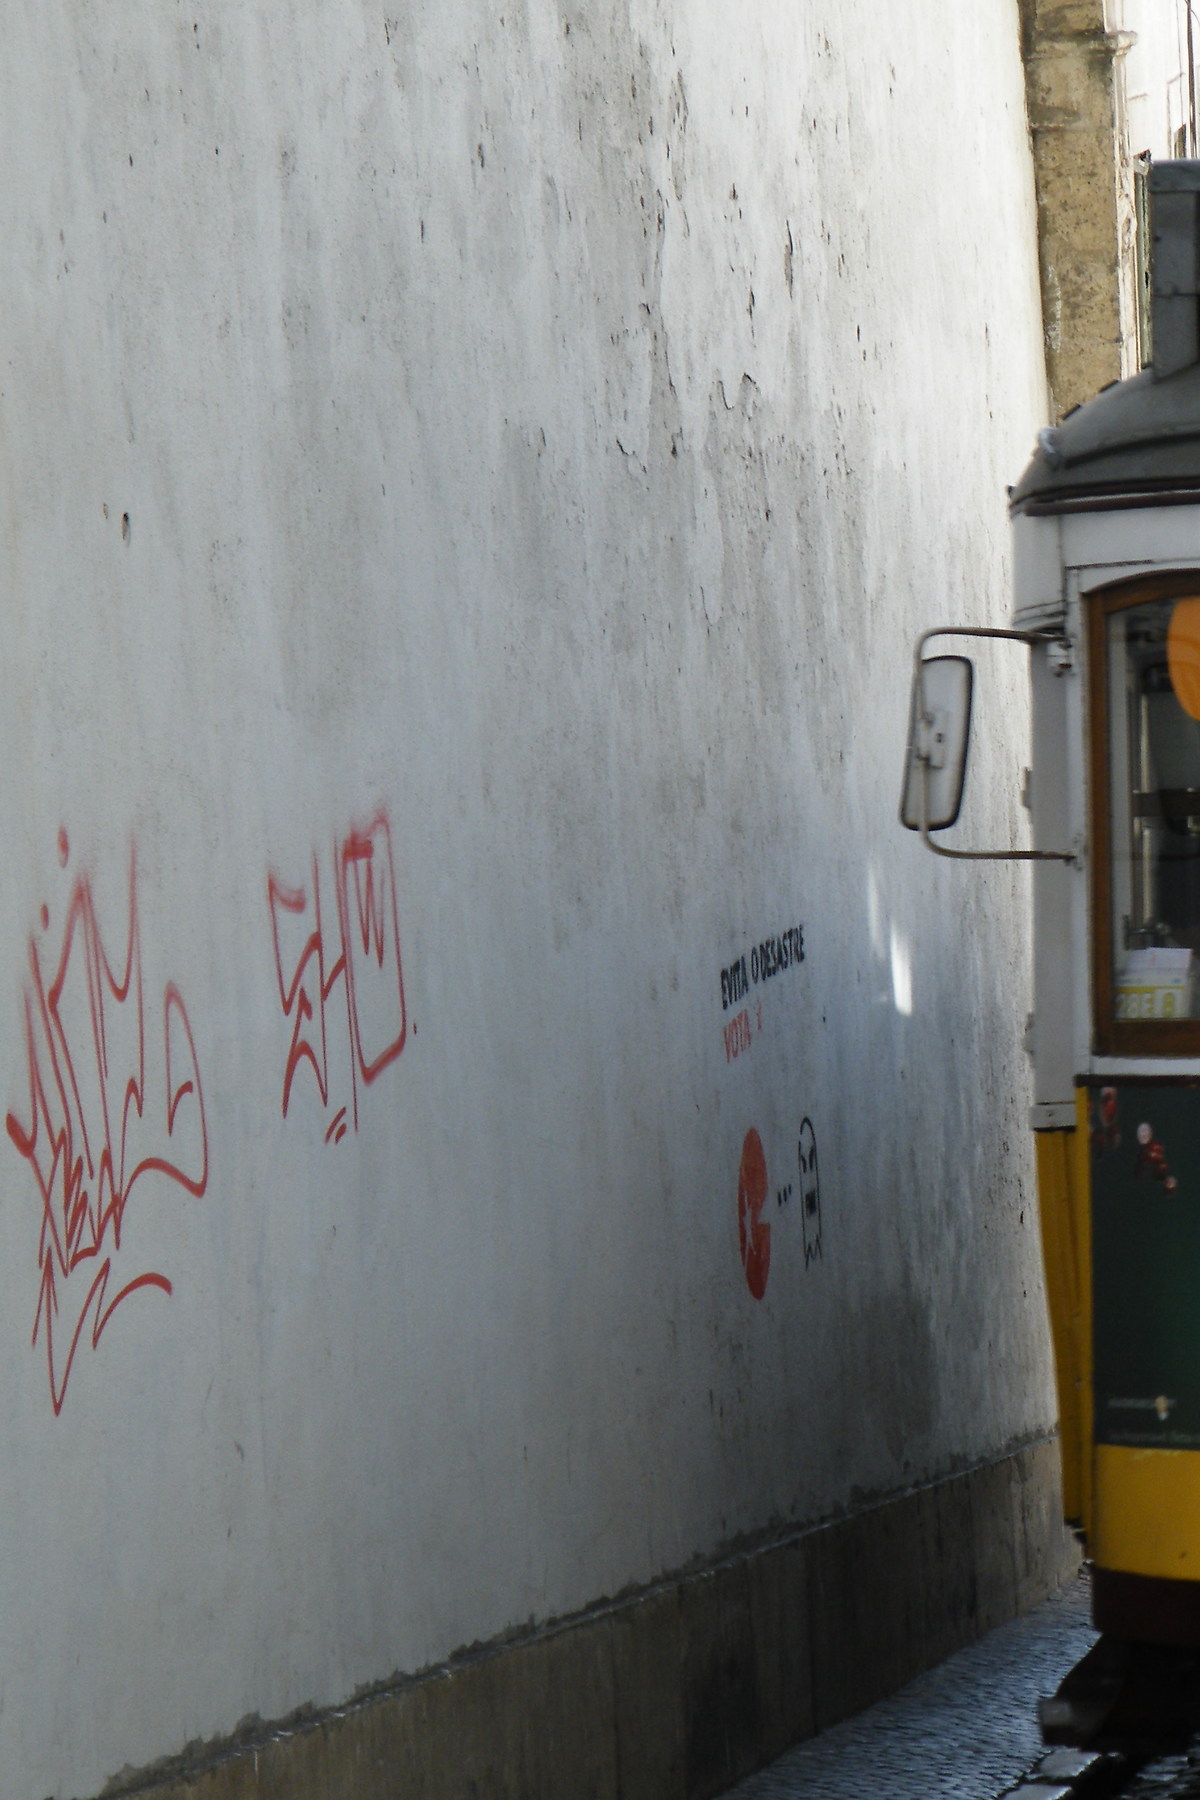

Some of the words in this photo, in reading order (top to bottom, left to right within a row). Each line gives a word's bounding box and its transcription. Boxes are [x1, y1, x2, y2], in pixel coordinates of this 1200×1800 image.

[720, 956, 749, 1011] EVITA
[751, 946, 759, 985] O
[759, 923, 805, 982] DESASTRE
[723, 1008, 752, 1064] VOTA
